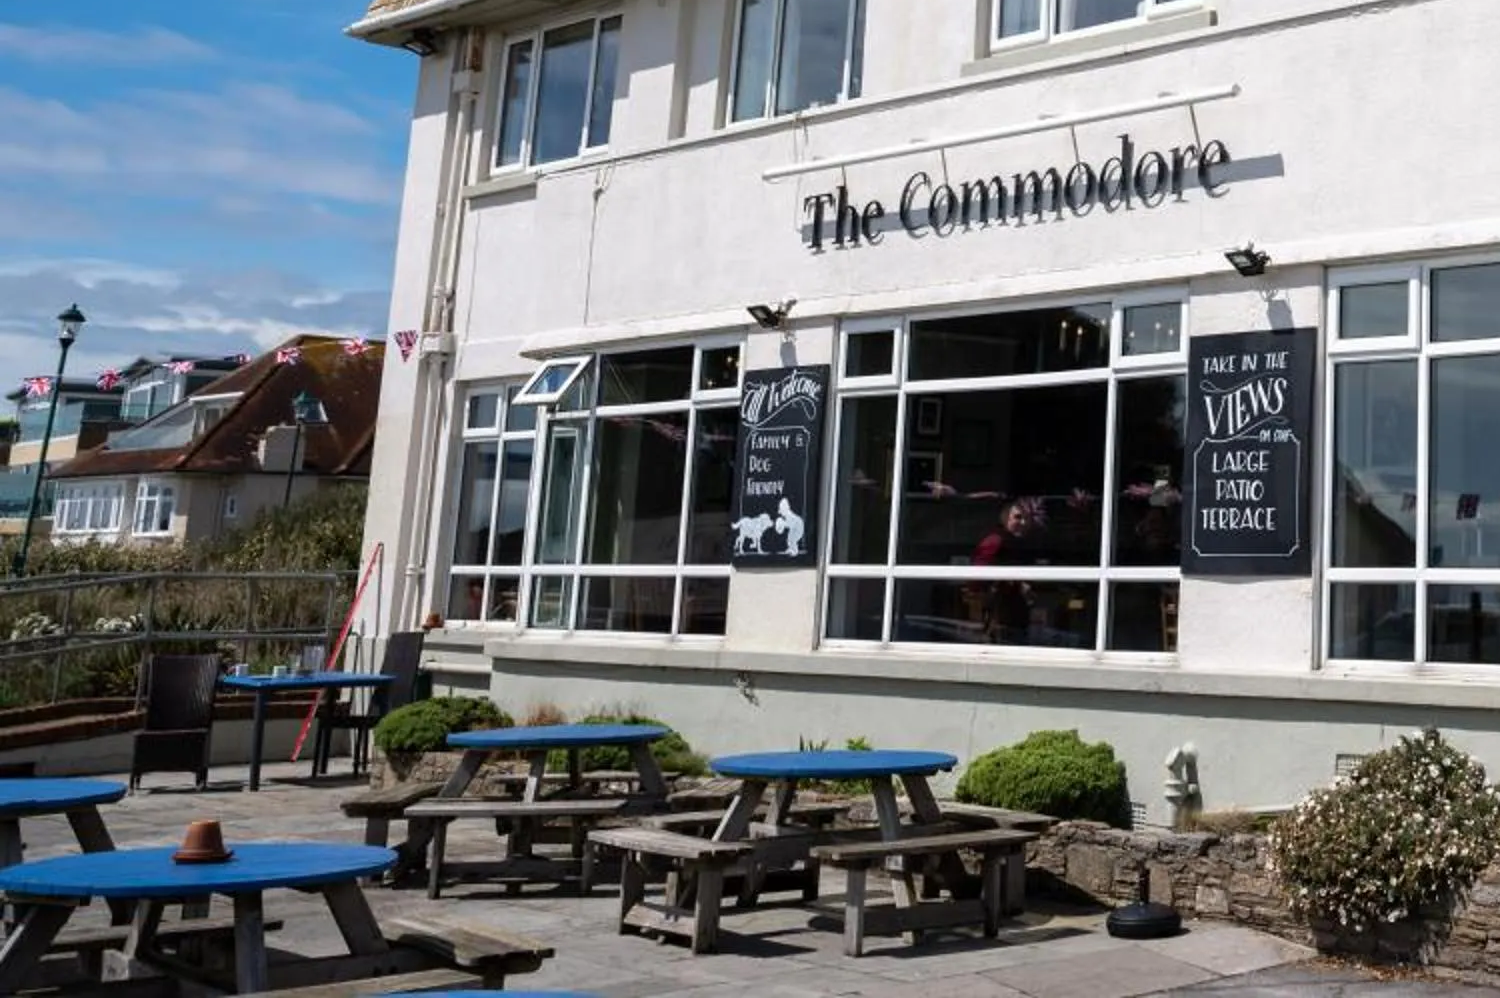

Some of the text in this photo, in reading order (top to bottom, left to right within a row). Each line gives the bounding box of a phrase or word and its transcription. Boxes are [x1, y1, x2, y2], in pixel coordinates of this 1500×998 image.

[803, 133, 1231, 251] The Commodore
[1202, 351, 1289, 375] TAKE IN THE
[1203, 377, 1288, 436] VIEWS
[1212, 450, 1271, 474] LARGE
[1215, 479, 1265, 501] PATIO
[1201, 507, 1277, 531] TERRACE
